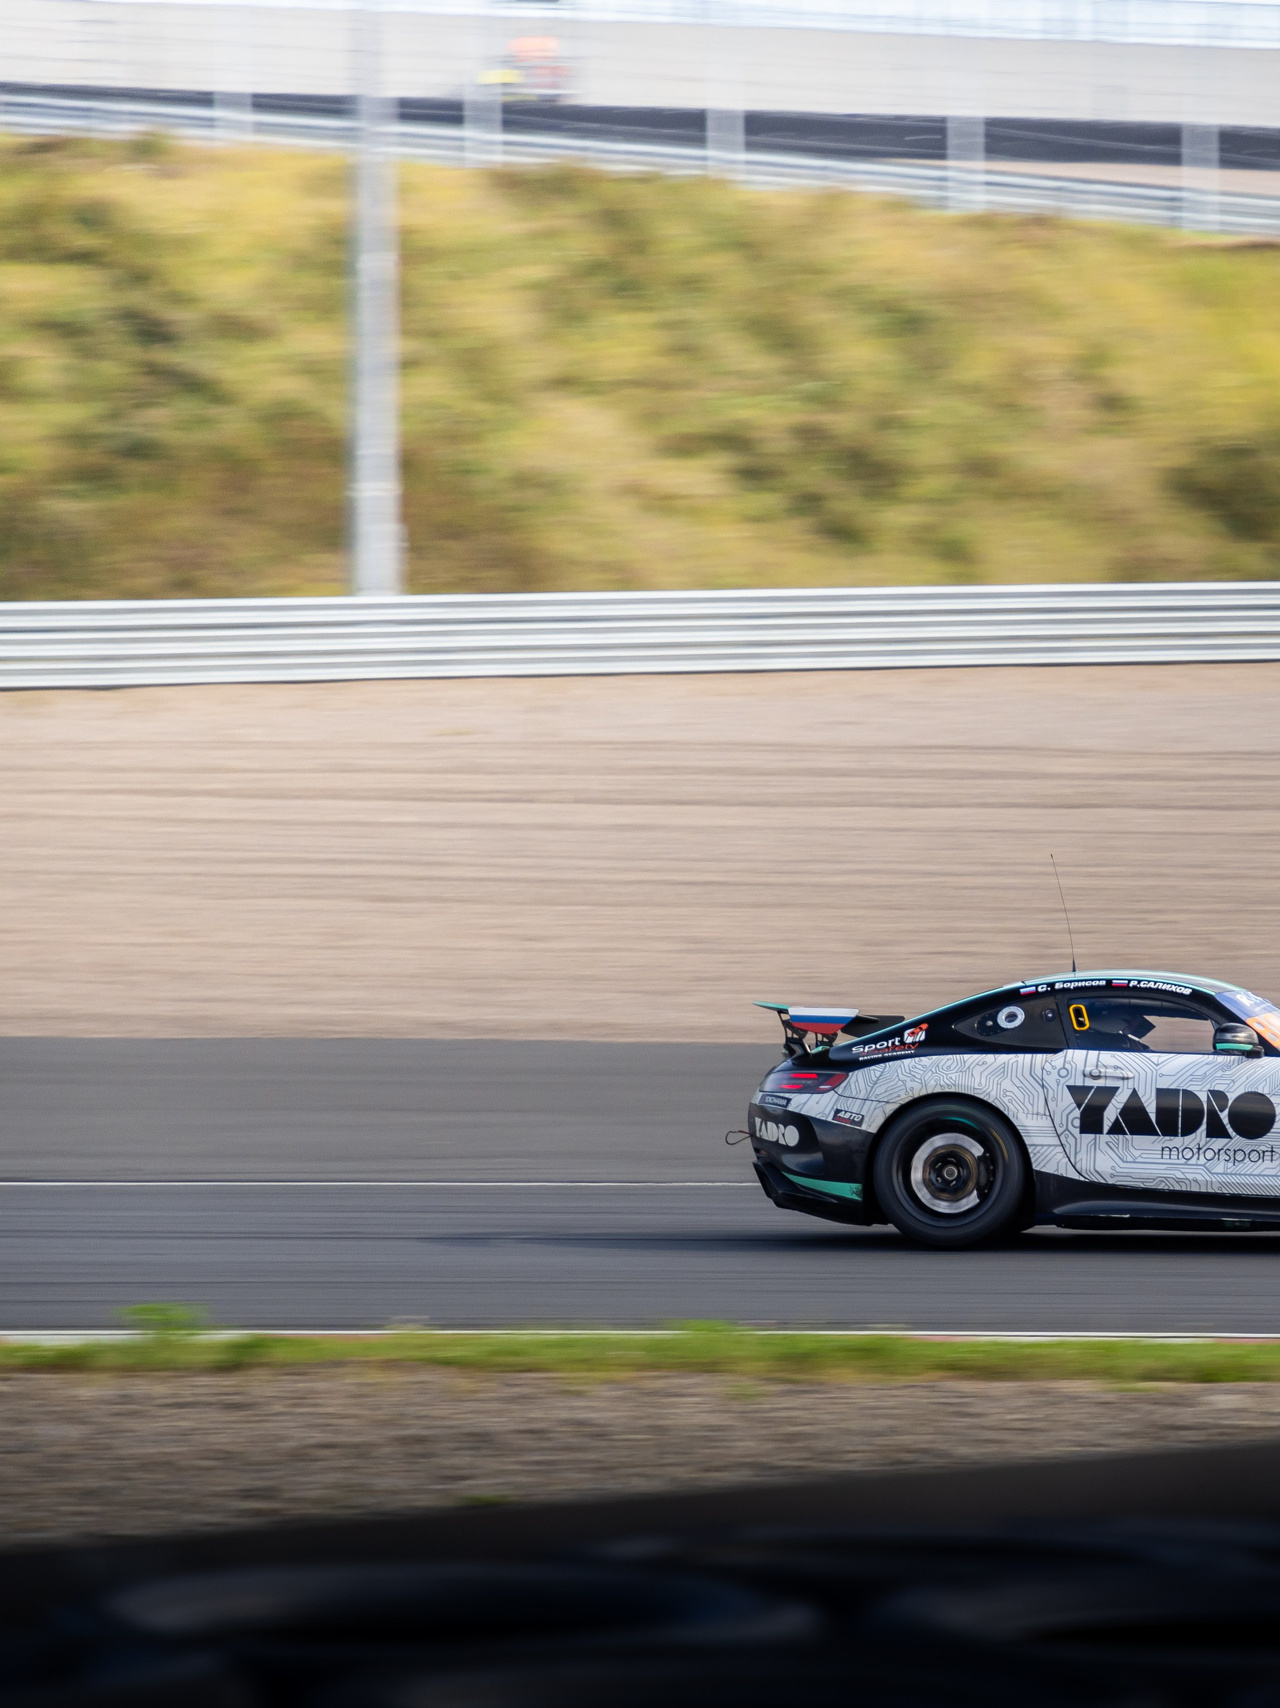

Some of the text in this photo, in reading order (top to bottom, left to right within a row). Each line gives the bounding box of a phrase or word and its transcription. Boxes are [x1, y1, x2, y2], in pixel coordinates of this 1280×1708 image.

[1054, 980, 1106, 989] Борисов
[851, 1037, 901, 1054] Sport
[1066, 1085, 1276, 1140] YADRO
[754, 1117, 800, 1147] YADRO
[1161, 1145, 1276, 1166] motorsport
